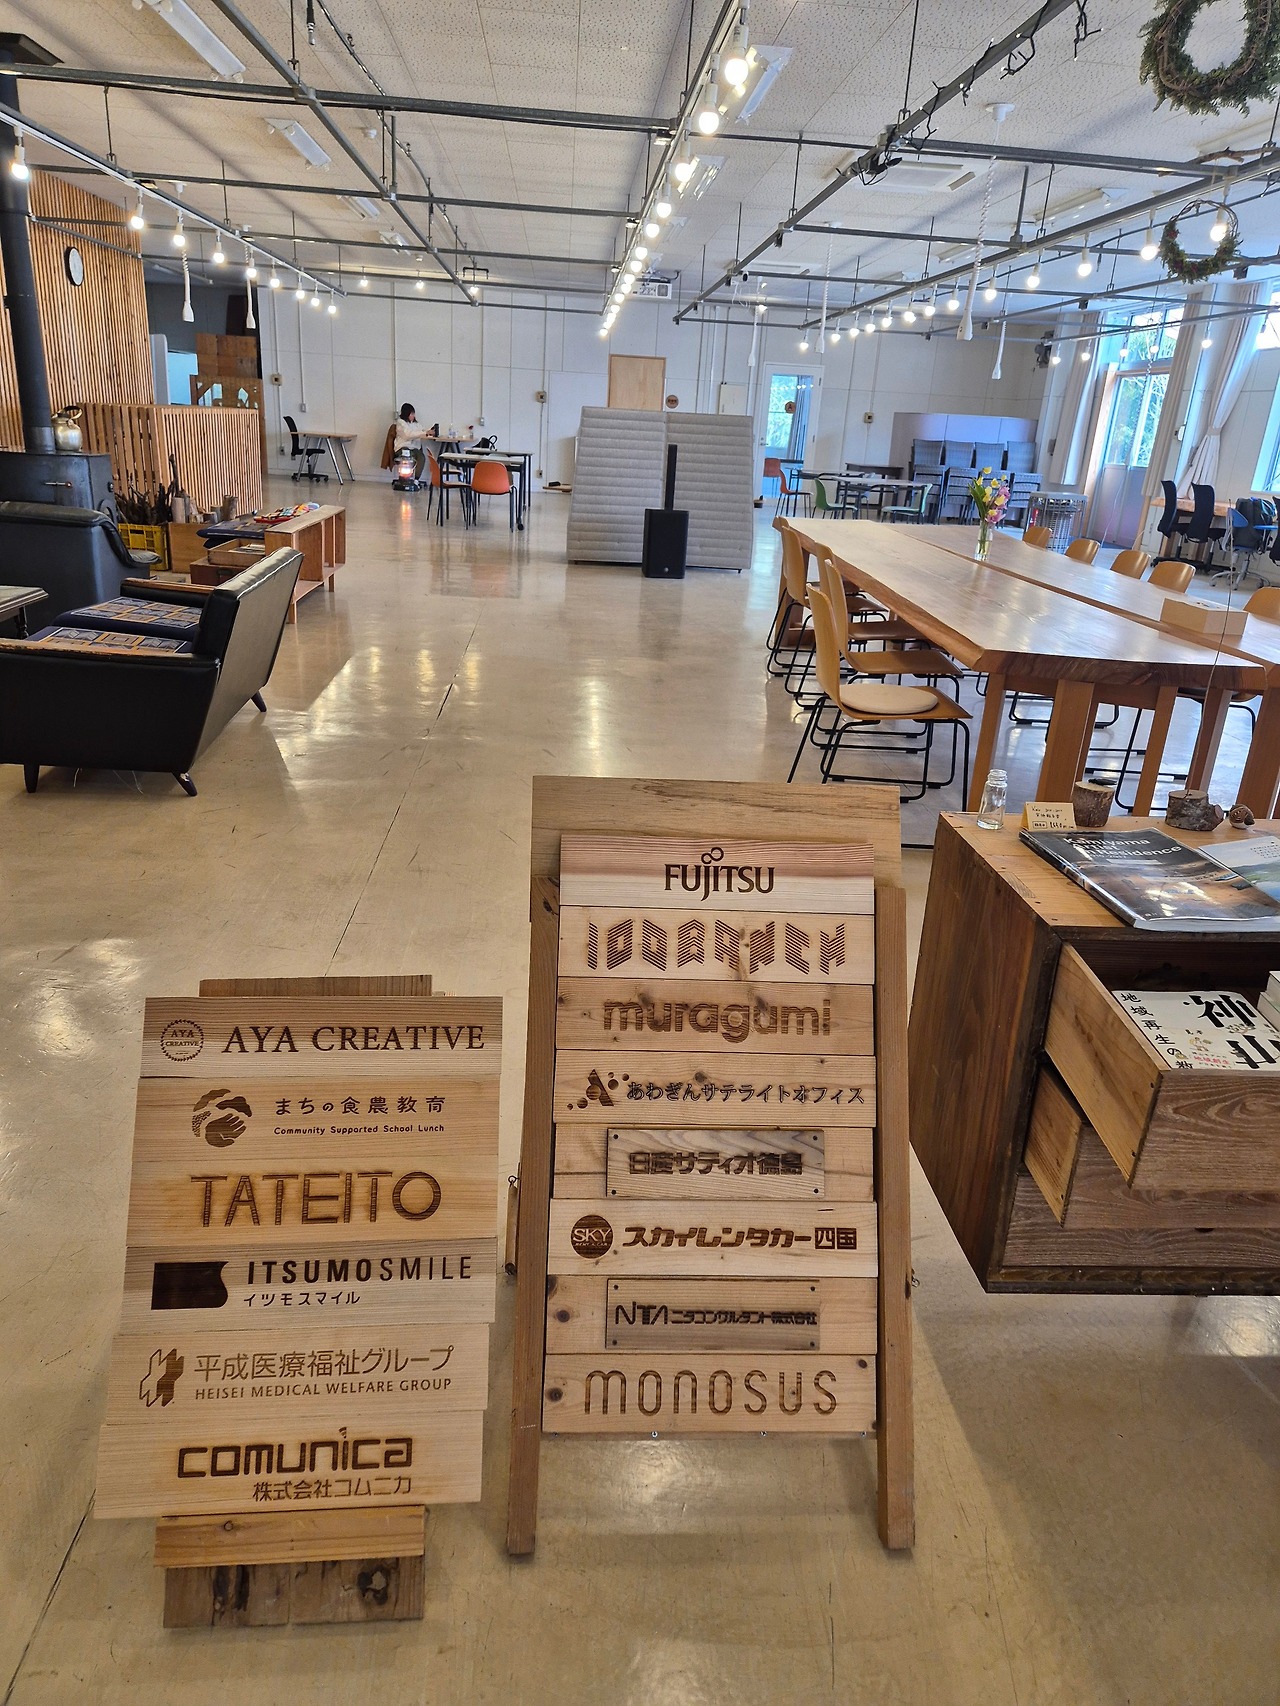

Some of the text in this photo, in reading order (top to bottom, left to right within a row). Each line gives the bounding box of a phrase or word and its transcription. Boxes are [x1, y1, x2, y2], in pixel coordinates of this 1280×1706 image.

[1063, 836, 1150, 846] Kamiyama
[664, 846, 776, 901] FUJITSU
[603, 999, 831, 1044] muragumi
[171, 1030, 194, 1038] AYA
[221, 1025, 485, 1054] AYA CREATIVE
[274, 1096, 447, 1115] まちの食農教育
[626, 1082, 865, 1105] あわぎんサテライトオフィス
[274, 1124, 445, 1136] Community Supported School Lunch
[190, 1171, 443, 1228] TATEITO
[573, 1228, 611, 1242] SKY
[622, 1226, 858, 1250] スカイレンタカー四国
[247, 1256, 473, 1285] ITSUMOSMILE
[243, 1290, 361, 1307] イツモスマイル
[194, 1344, 455, 1382] 平成医療福祉グループ
[195, 1378, 452, 1400] HEISEI MEDICAL WELFARE GROUP
[177, 1427, 413, 1479] comunica
[252, 1476, 412, 1502] 株式会社コムニカ
